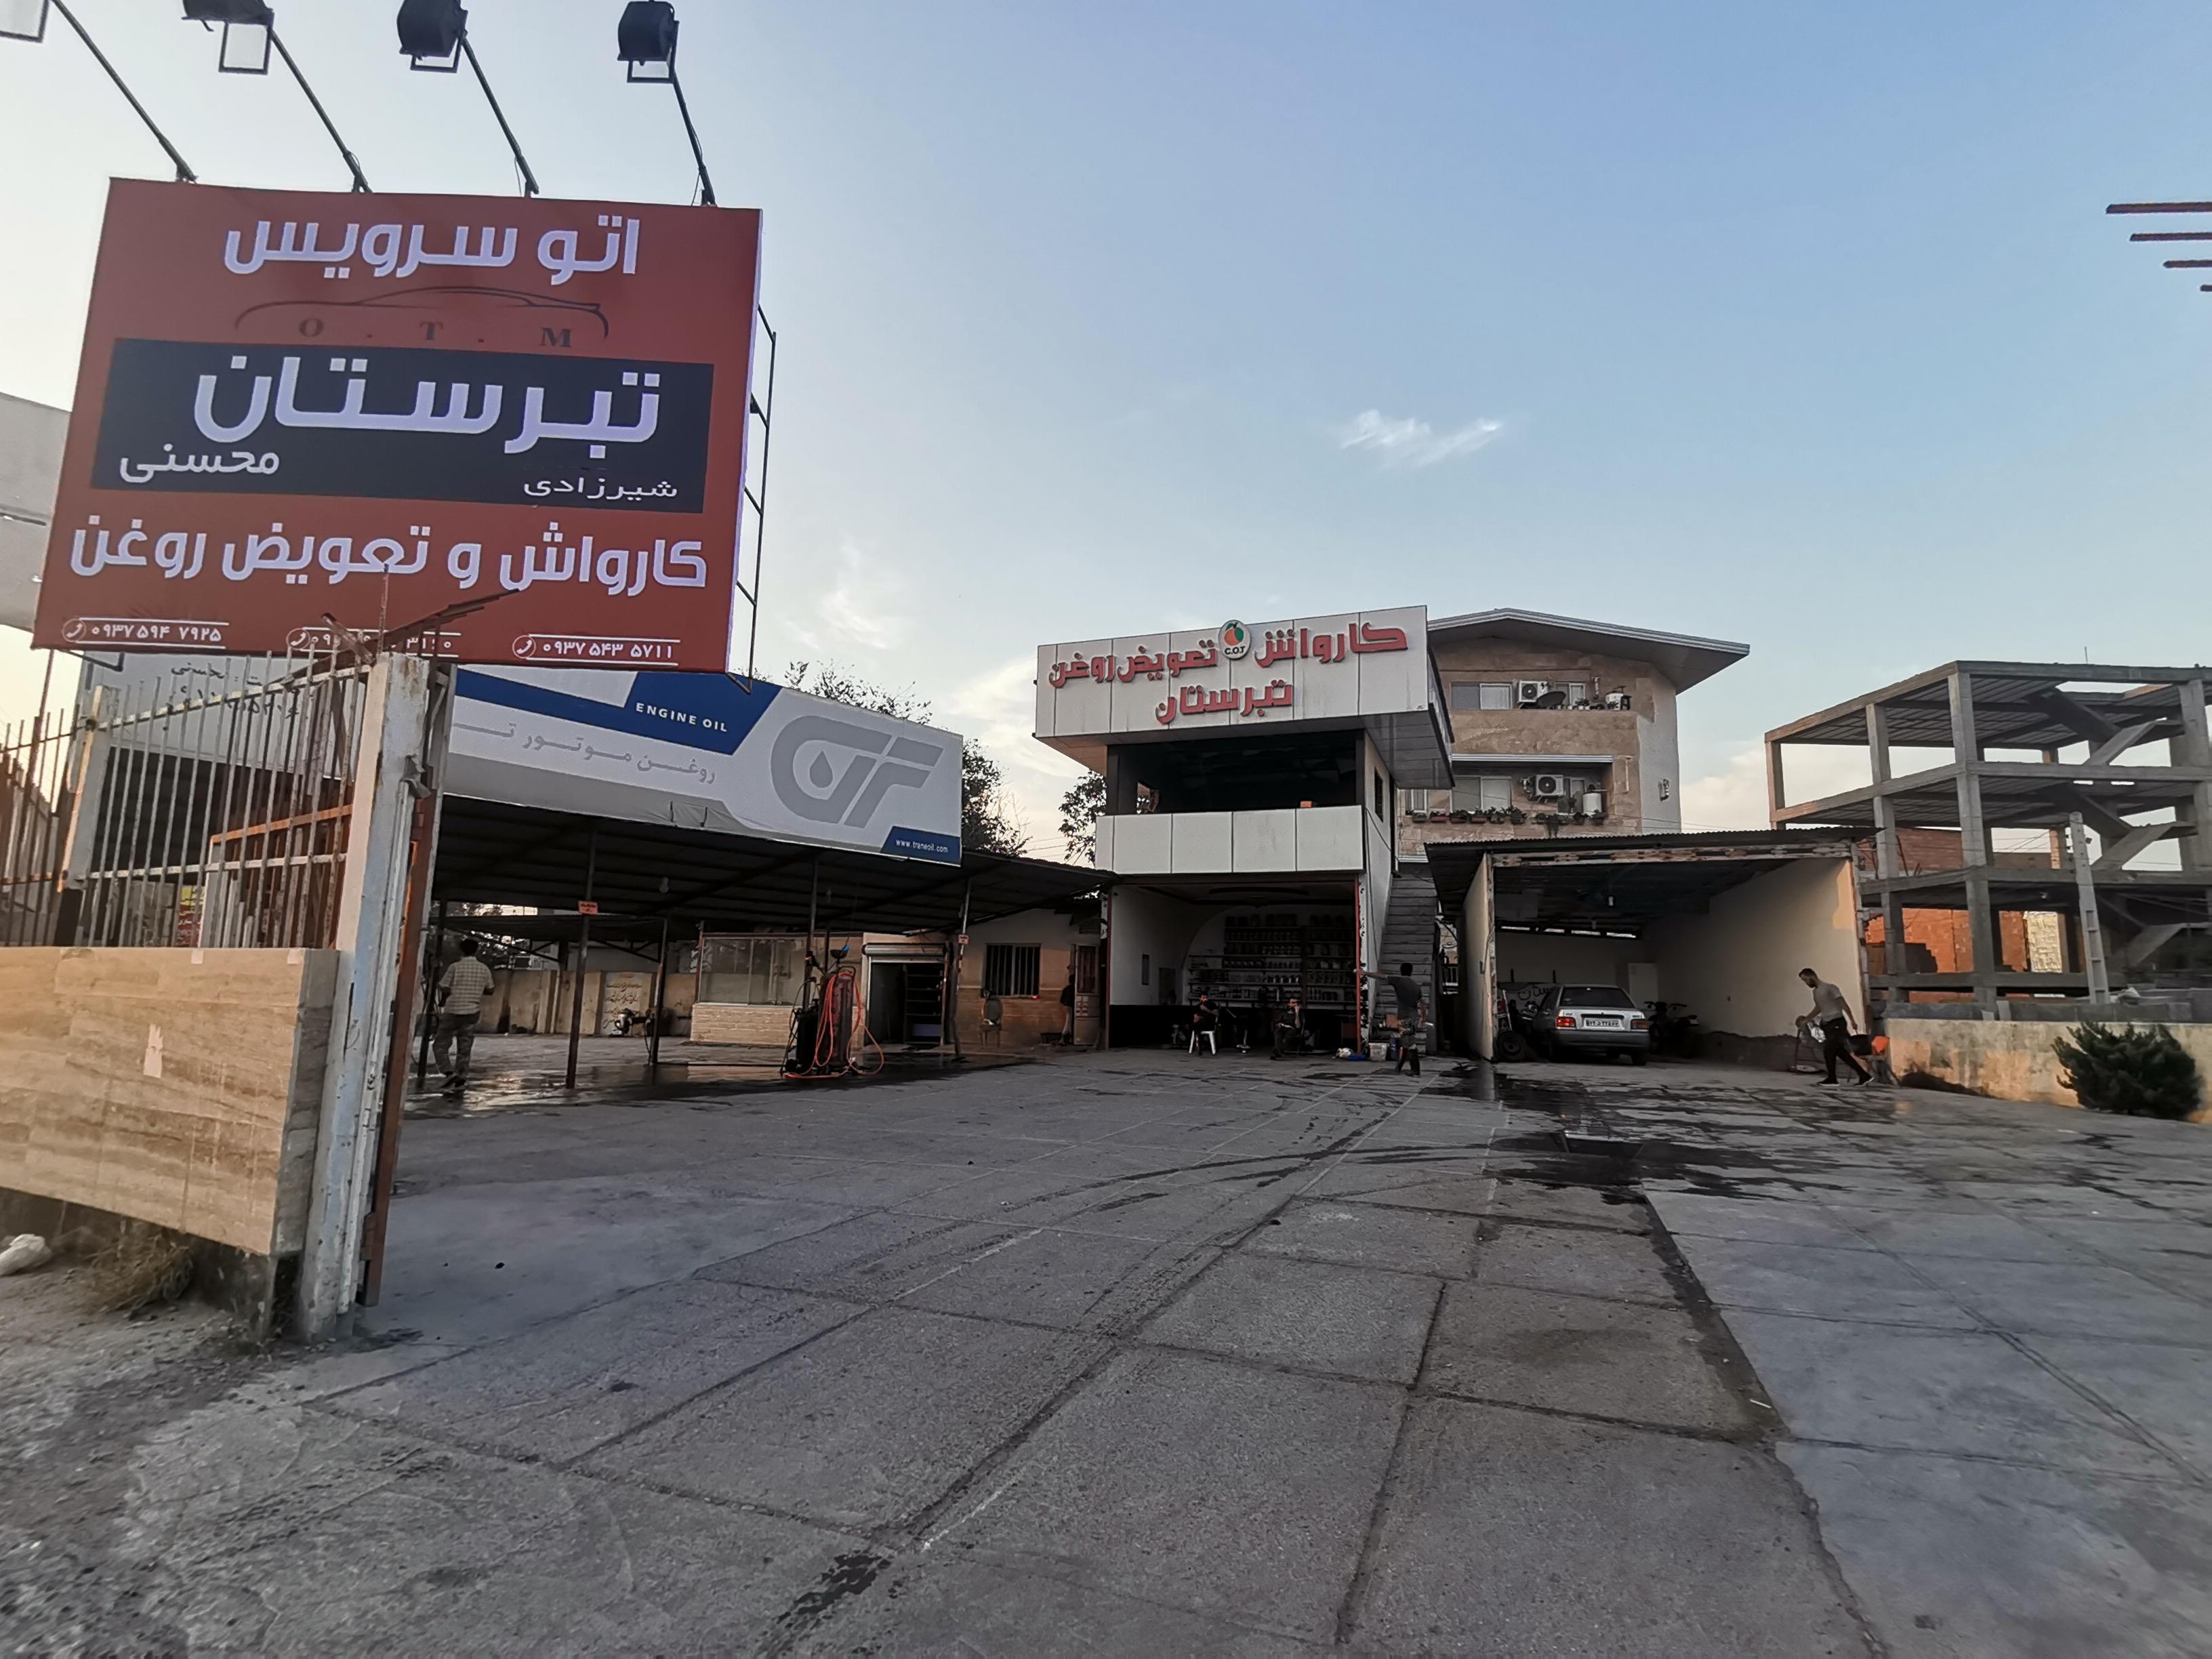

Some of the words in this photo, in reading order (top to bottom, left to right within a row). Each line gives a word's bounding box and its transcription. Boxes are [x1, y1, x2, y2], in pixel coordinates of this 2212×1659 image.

[224, 220, 518, 279] سرویس
[537, 215, 640, 285] اتو
[193, 356, 660, 459] تبرستان
[119, 443, 279, 483] محسنی
[524, 477, 677, 501] شیرزادی
[70, 514, 207, 579] روغن
[222, 523, 431, 585] تعویض
[447, 543, 482, 589] و
[499, 521, 707, 596] کارواش
[1118, 639, 1217, 682] تعویض
[1254, 623, 1408, 668] کارواش
[1049, 653, 1116, 689] روغن
[636, 702, 697, 725] ENGINE
[702, 718, 727, 732] OIL
[1155, 680, 1294, 724] تبرستان
[522, 737, 632, 761] موتور
[636, 758, 717, 785] روغن
[895, 840, 949, 853] www.traneoil.com
